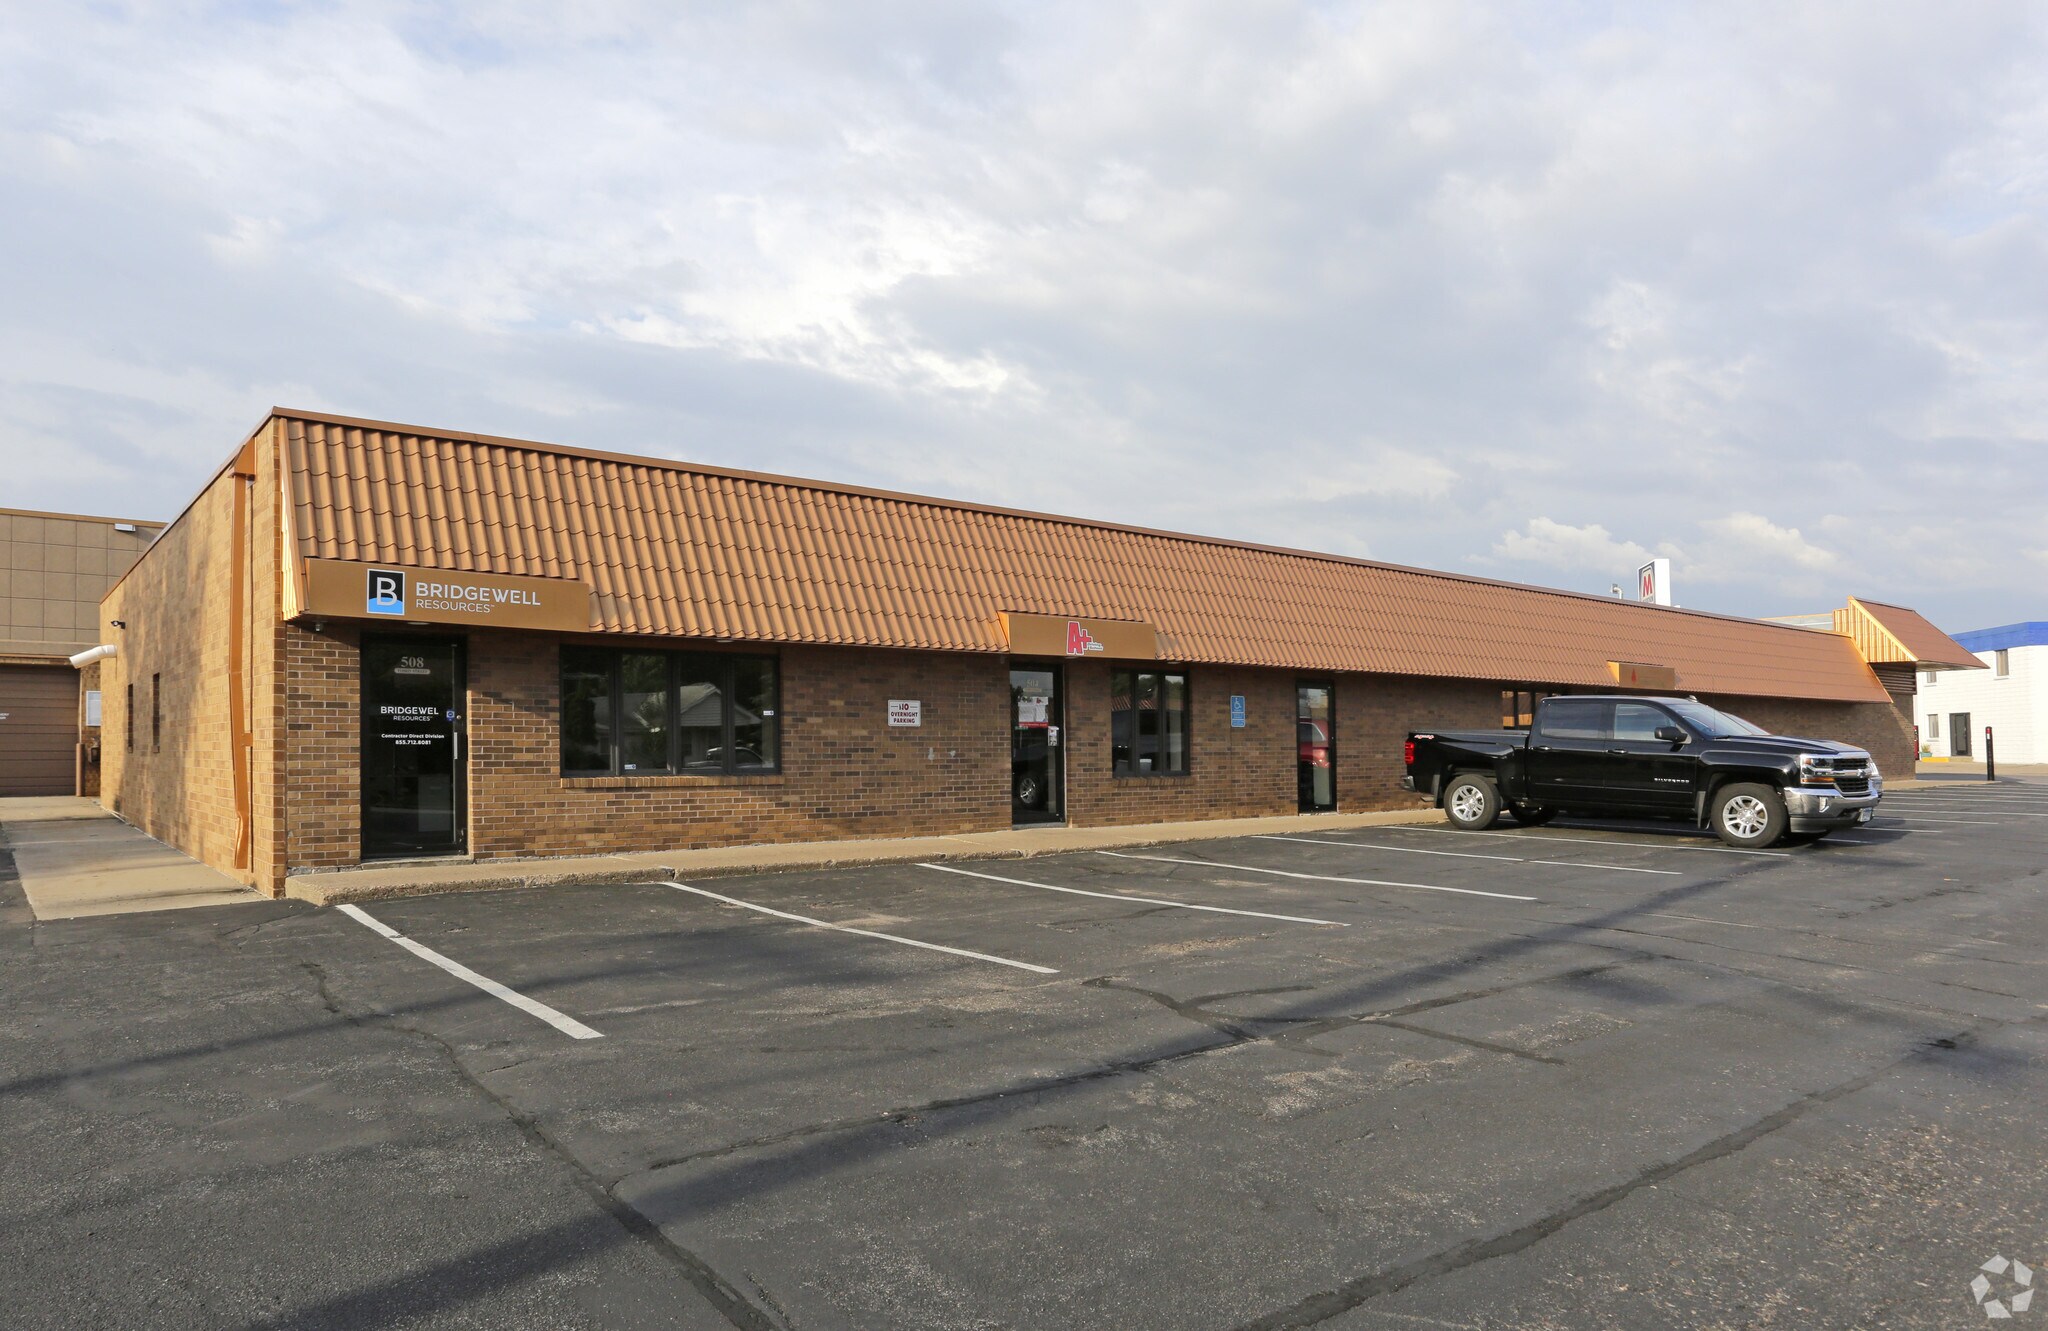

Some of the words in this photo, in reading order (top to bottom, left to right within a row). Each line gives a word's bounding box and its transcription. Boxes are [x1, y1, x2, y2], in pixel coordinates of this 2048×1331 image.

[376, 577, 398, 606] B
[416, 581, 542, 606] BRIDGEWELL
[1643, 574, 1653, 597] M
[400, 656, 424, 668] 508
[380, 706, 439, 715] BRIDGEWEL
